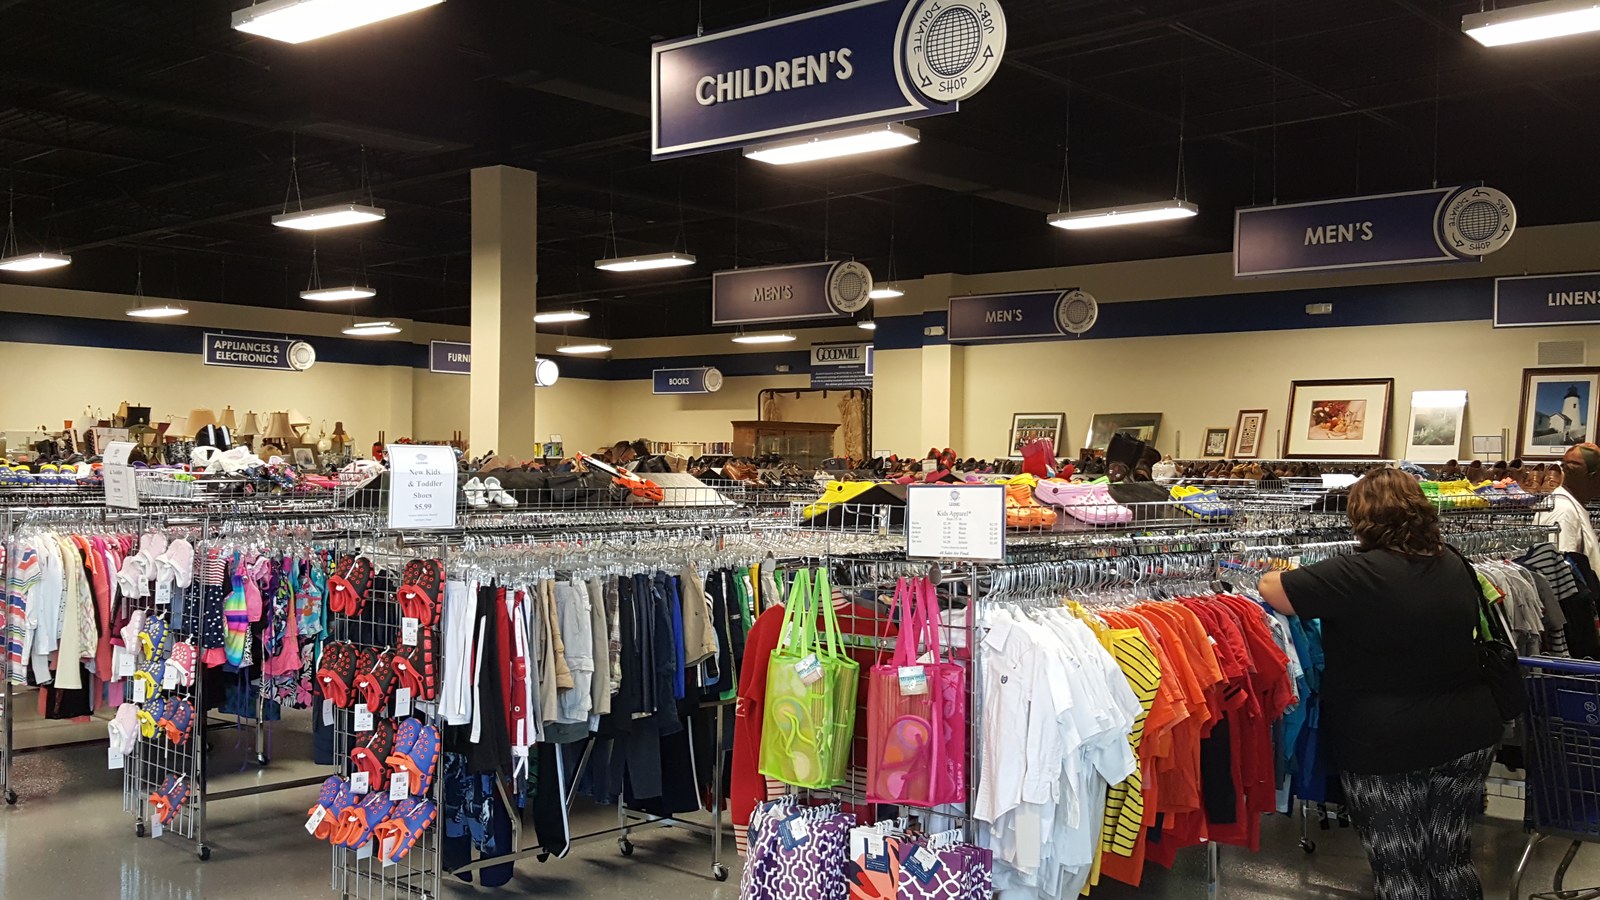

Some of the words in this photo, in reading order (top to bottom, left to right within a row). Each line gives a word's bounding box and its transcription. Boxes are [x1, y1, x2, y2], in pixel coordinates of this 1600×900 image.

[976, 2, 995, 34] JOBS
[913, 1, 942, 55] DONATE
[695, 47, 853, 106] CHILDREN'S
[938, 76, 967, 94] SHOP
[1448, 197, 1469, 228] DONATE
[1496, 198, 1510, 218] JOBS
[1304, 221, 1374, 246] MEN'S
[1469, 241, 1491, 251] SHOP
[753, 284, 794, 302] MEN'S
[1548, 290, 1600, 307] LINEN
[985, 309, 1023, 323] MEN'S
[214, 340, 271, 353] APPLIANCES
[273, 345, 280, 354] &
[216, 351, 278, 364] ELECTRONICS
[669, 377, 690, 386] BOOKS
[425, 468, 441, 476] Kids
[414, 503, 432, 511] $5.99
